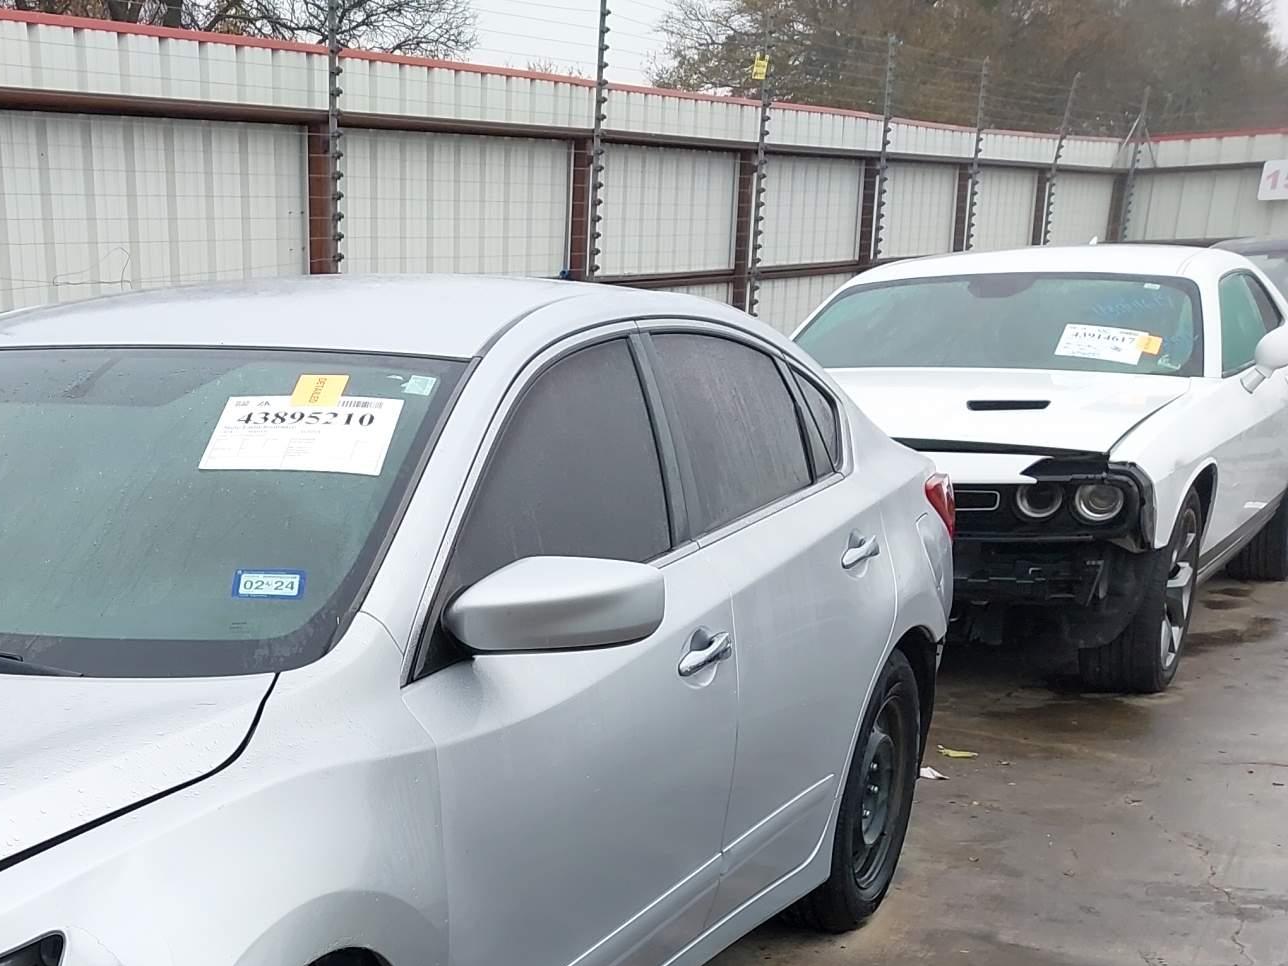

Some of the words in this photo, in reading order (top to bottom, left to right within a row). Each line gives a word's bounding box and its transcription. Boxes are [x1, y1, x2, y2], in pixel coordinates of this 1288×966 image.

[237, 411, 376, 427] 43895210
[243, 580, 265, 590] 02
[273, 581, 295, 591] 24
